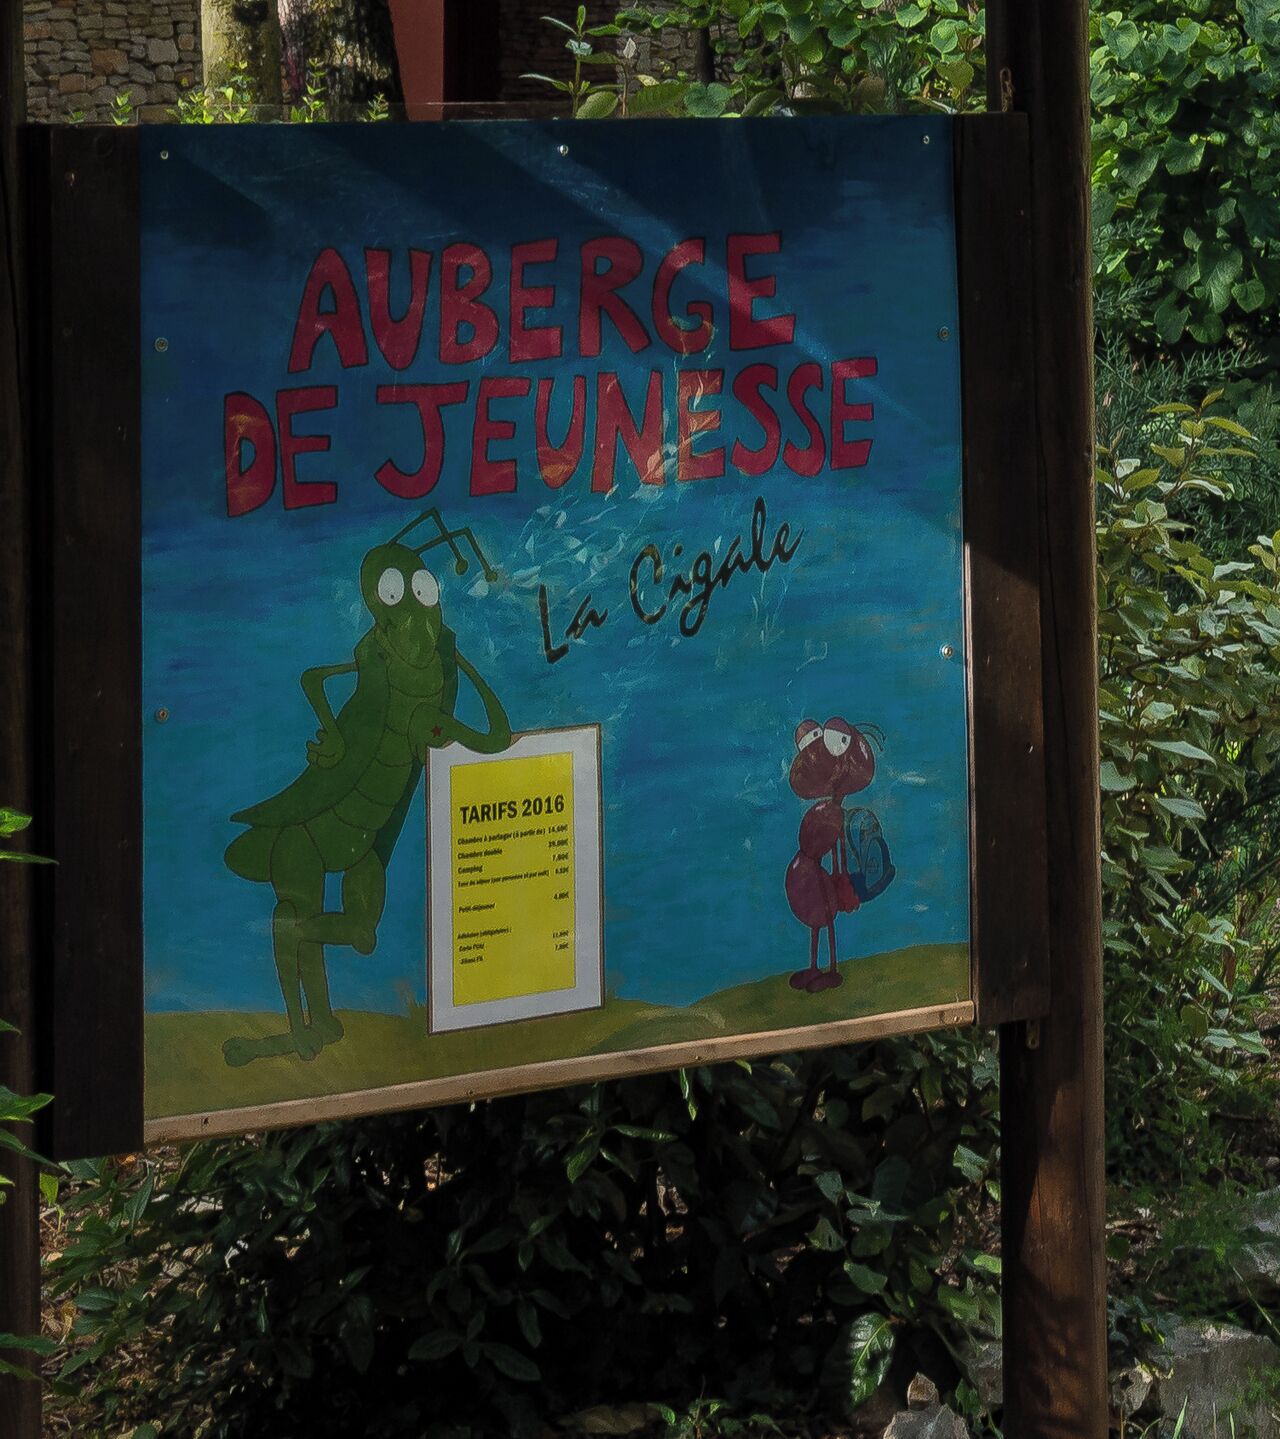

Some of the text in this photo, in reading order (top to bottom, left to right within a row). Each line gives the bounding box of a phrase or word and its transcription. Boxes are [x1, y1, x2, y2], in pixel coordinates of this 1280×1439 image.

[287, 231, 796, 374] AUBERGE
[223, 356, 879, 518] DE JEUNESSE
[538, 495, 808, 665] La Cigale
[460, 794, 565, 825] TARIFS 2016
